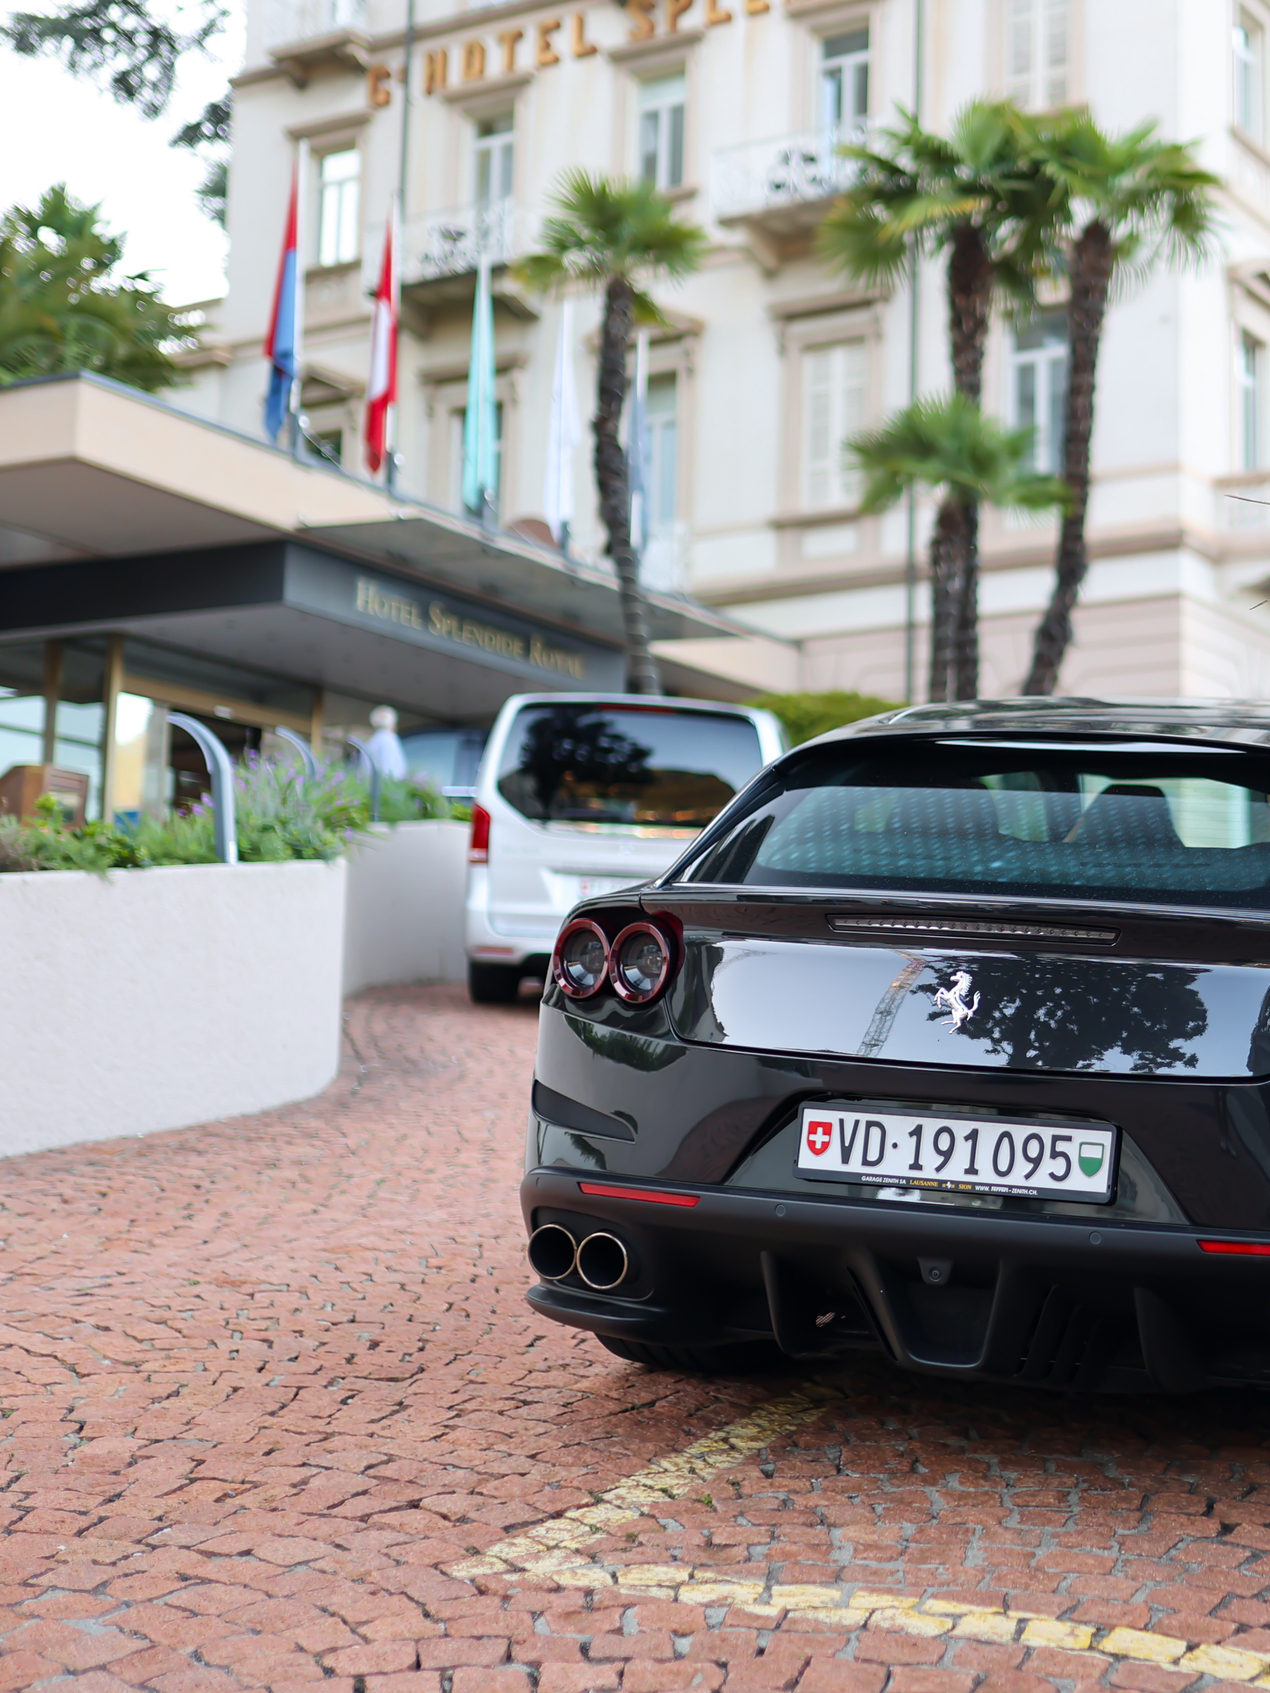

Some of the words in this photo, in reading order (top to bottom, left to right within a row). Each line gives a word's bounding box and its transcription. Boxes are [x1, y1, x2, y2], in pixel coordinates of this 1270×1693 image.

[424, 12, 598, 95] HOTEL
[356, 577, 422, 630] HOTEL
[428, 601, 523, 661] SPLENDIDE
[861, 1175, 882, 1183] GARAGE
[909, 1179, 939, 1187] LAUSANNE
